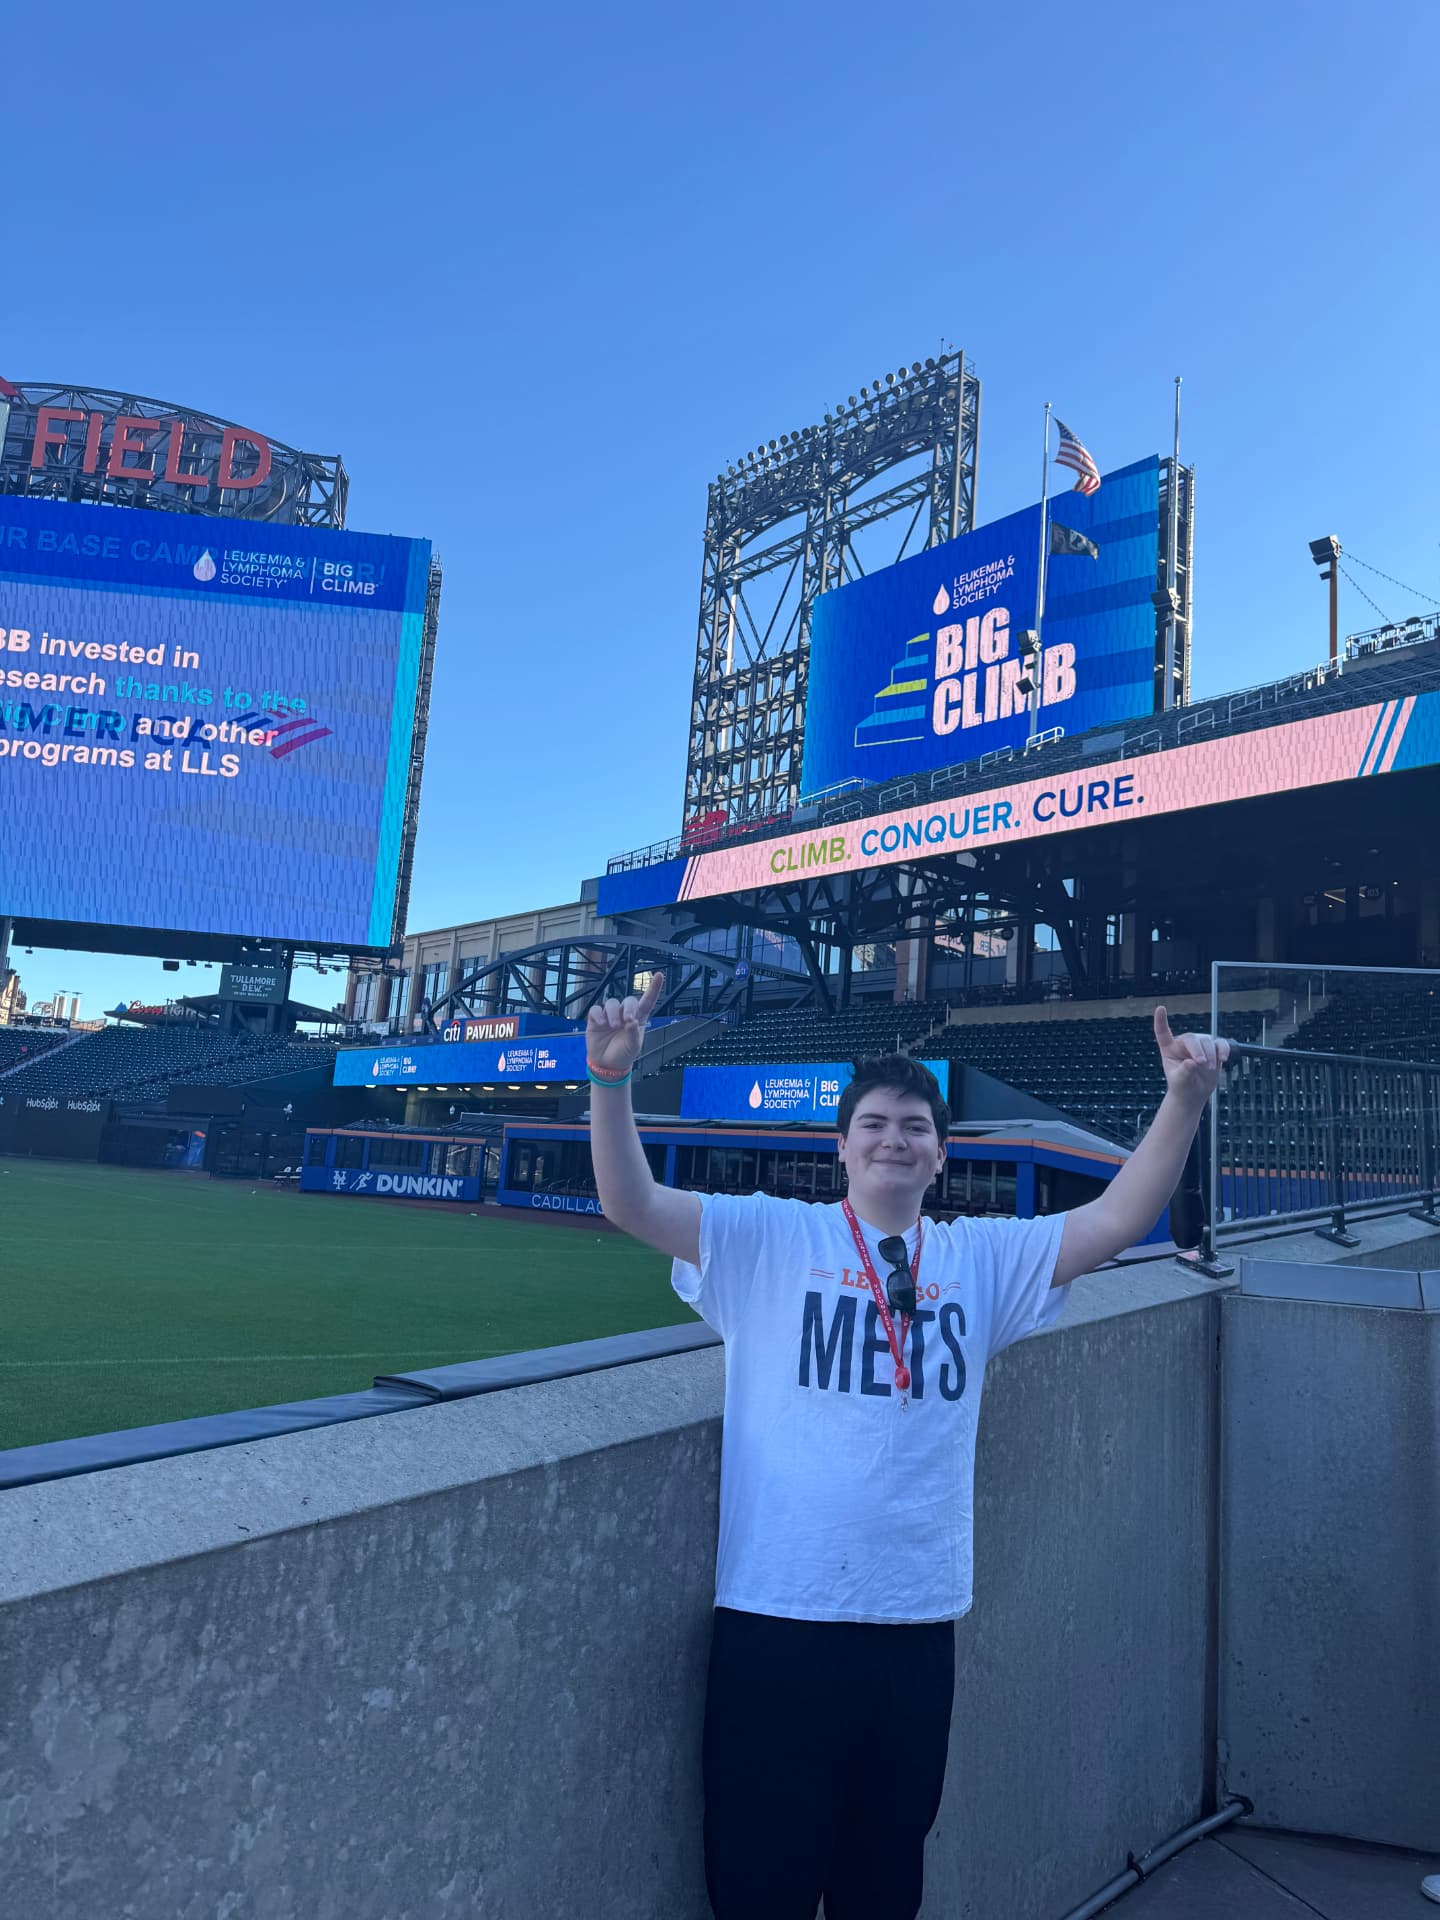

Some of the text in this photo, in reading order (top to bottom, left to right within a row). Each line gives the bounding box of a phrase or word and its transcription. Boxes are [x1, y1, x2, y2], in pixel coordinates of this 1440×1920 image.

[31, 407, 272, 489] FIELD
[37, 529, 121, 558] BASE
[222, 562, 304, 579] LYMPHOMA
[224, 550, 305, 568] LEUKEMIA &
[323, 562, 353, 577] BIG
[953, 554, 1015, 587] LEUKEMIA &
[220, 573, 284, 589] SOCIETY
[321, 578, 376, 596] CLIMB
[953, 567, 1014, 598] LYMPHOMA
[953, 583, 1000, 609] SOCIETY
[40, 632, 165, 666] invested
[173, 645, 199, 670] in
[935, 607, 1010, 680] BIG
[115, 675, 213, 706] thanks
[223, 687, 252, 710] to
[261, 689, 307, 714] the
[932, 643, 1076, 736] CLIMB
[136, 716, 191, 739] and
[200, 721, 279, 748] other
[144, 749, 173, 772] at
[181, 750, 240, 778] LLS
[770, 774, 1144, 874] CLIMB. CONQUER. CURE.
[230, 974, 277, 986] TULLAMORE
[443, 1021, 514, 1043] citi PAVILION
[764, 1089, 809, 1098] LYMPHOMA
[765, 1079, 811, 1088] LEUKEMIA &
[821, 1080, 838, 1092] BIG
[26, 1096, 59, 1110] HubSpot
[67, 1099, 101, 1112] HubSpot
[764, 1099, 799, 1109] SOCIETY
[820, 1095, 840, 1106] CLI
[873, 1283, 892, 1331] VOLUNTEER
[799, 1290, 967, 1401] METS
